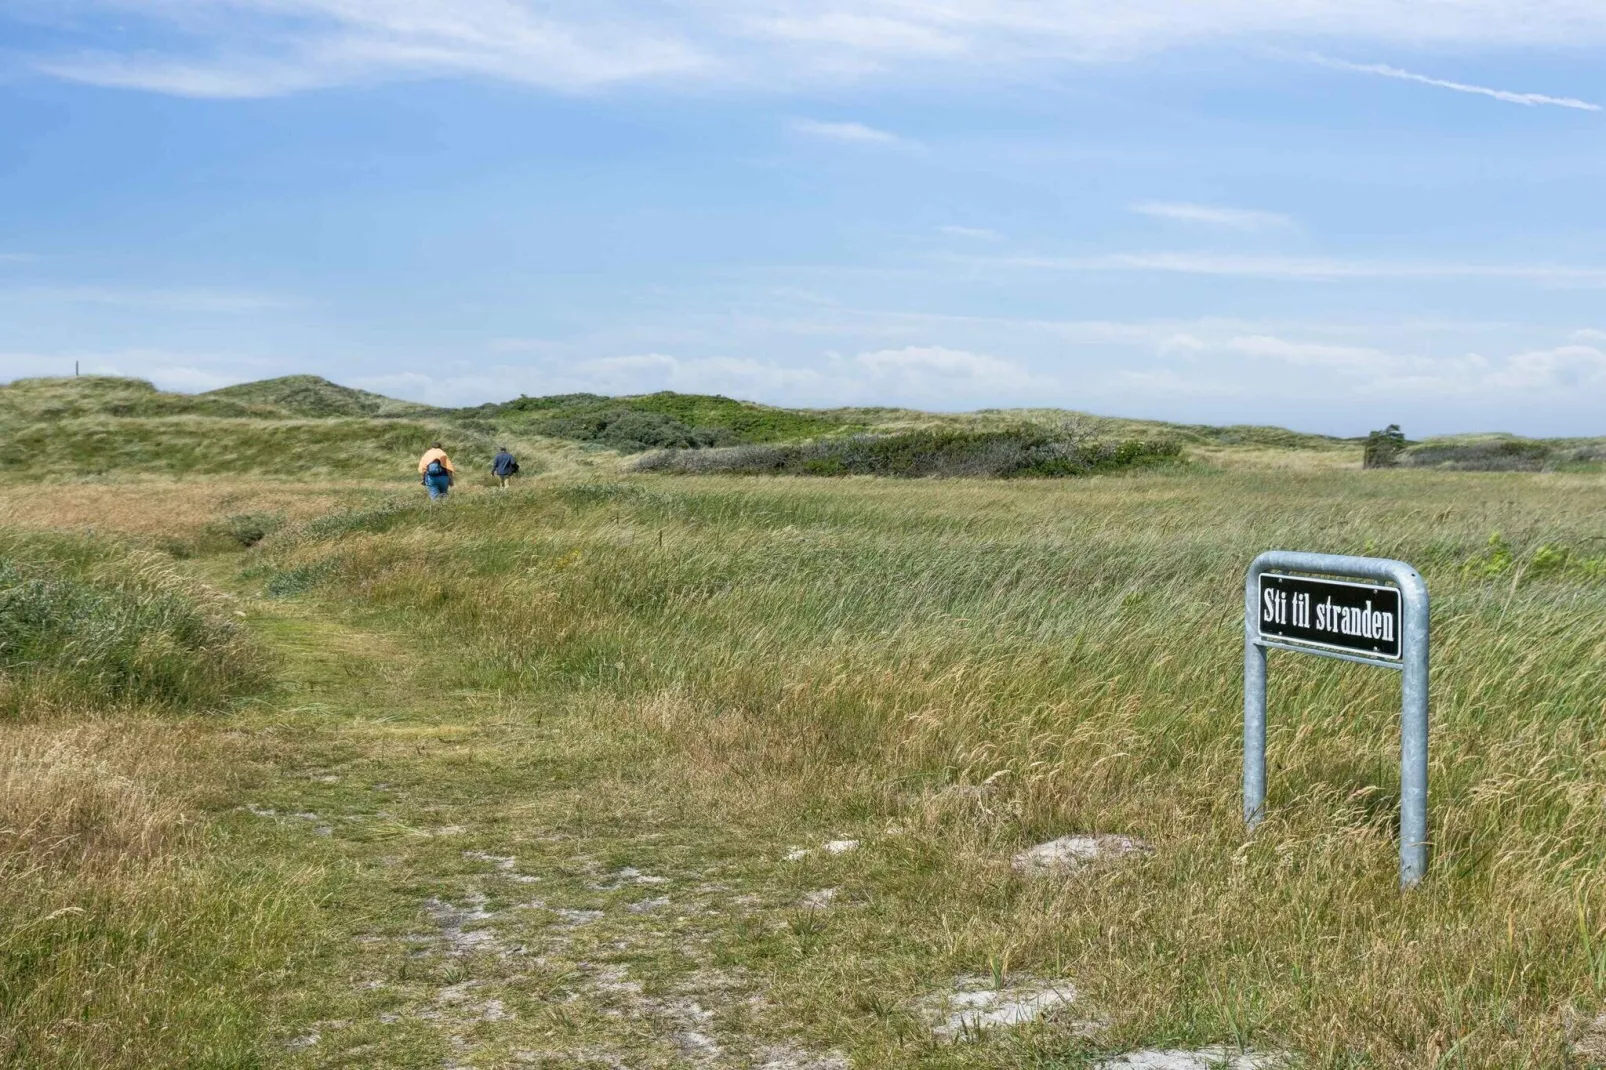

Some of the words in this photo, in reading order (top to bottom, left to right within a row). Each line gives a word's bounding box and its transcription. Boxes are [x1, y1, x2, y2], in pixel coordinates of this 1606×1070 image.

[1264, 588, 1287, 625] Sti
[1292, 592, 1310, 629] til
[1316, 595, 1394, 642] stranden
